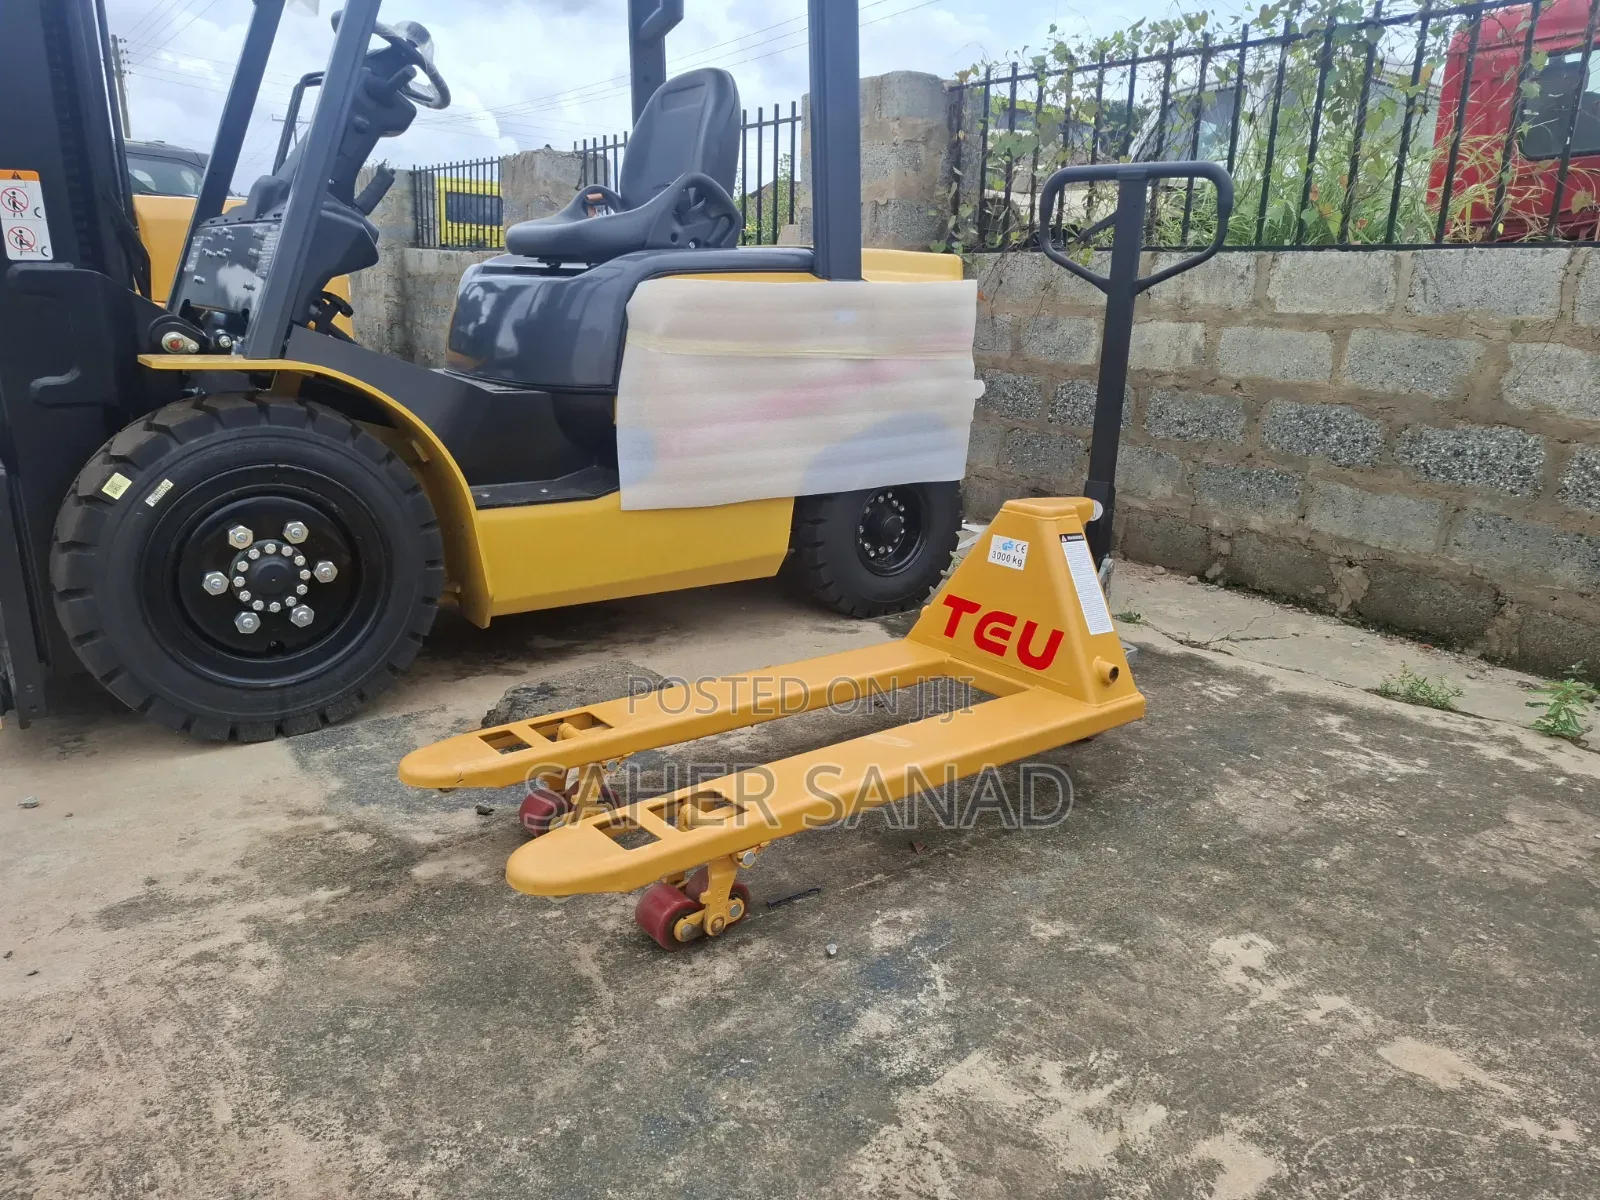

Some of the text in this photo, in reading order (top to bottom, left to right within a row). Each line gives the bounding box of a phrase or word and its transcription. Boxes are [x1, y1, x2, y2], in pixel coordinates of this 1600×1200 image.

[1002, 540, 1027, 554] GS CE
[992, 550, 1023, 567] 3000 kg
[943, 594, 1065, 671] TEU
